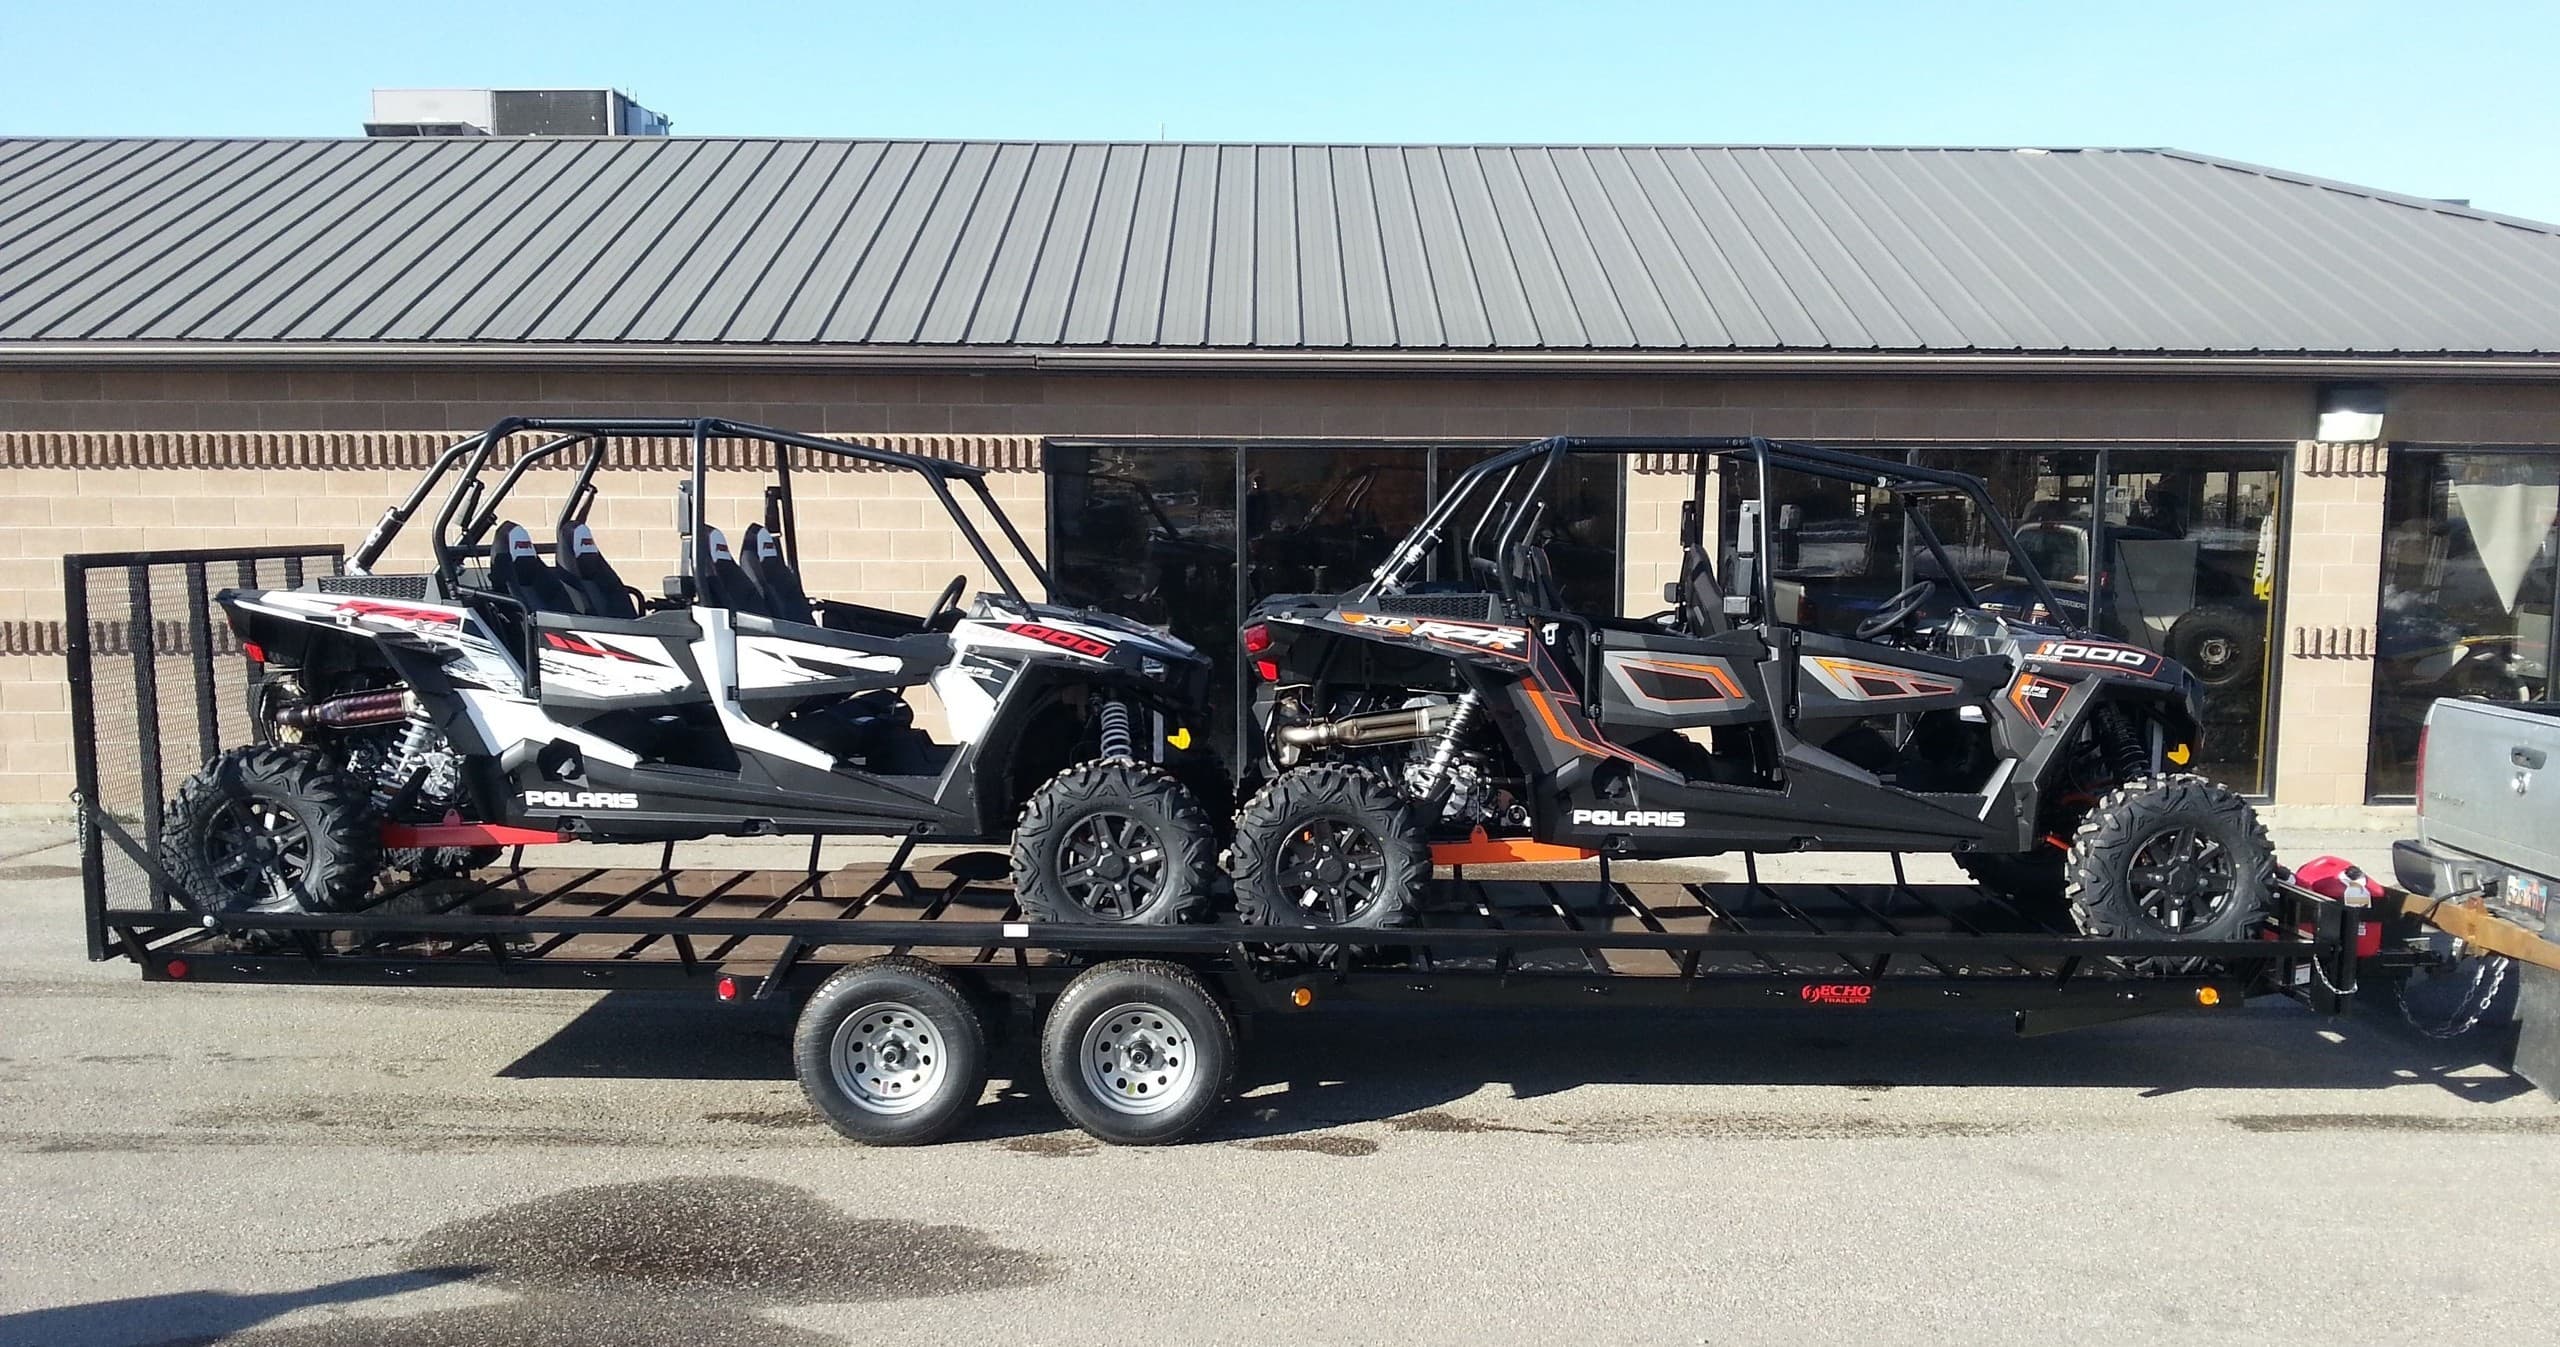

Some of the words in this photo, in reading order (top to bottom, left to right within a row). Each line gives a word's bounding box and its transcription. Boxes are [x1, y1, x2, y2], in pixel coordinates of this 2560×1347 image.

[1360, 615, 1408, 628] XP
[1004, 623, 1112, 657] 1000
[2042, 643, 2146, 666] 1000
[525, 791, 638, 808] POLARIS
[1573, 810, 1686, 827] POLARIS
[1820, 985, 1871, 996] ECHO
